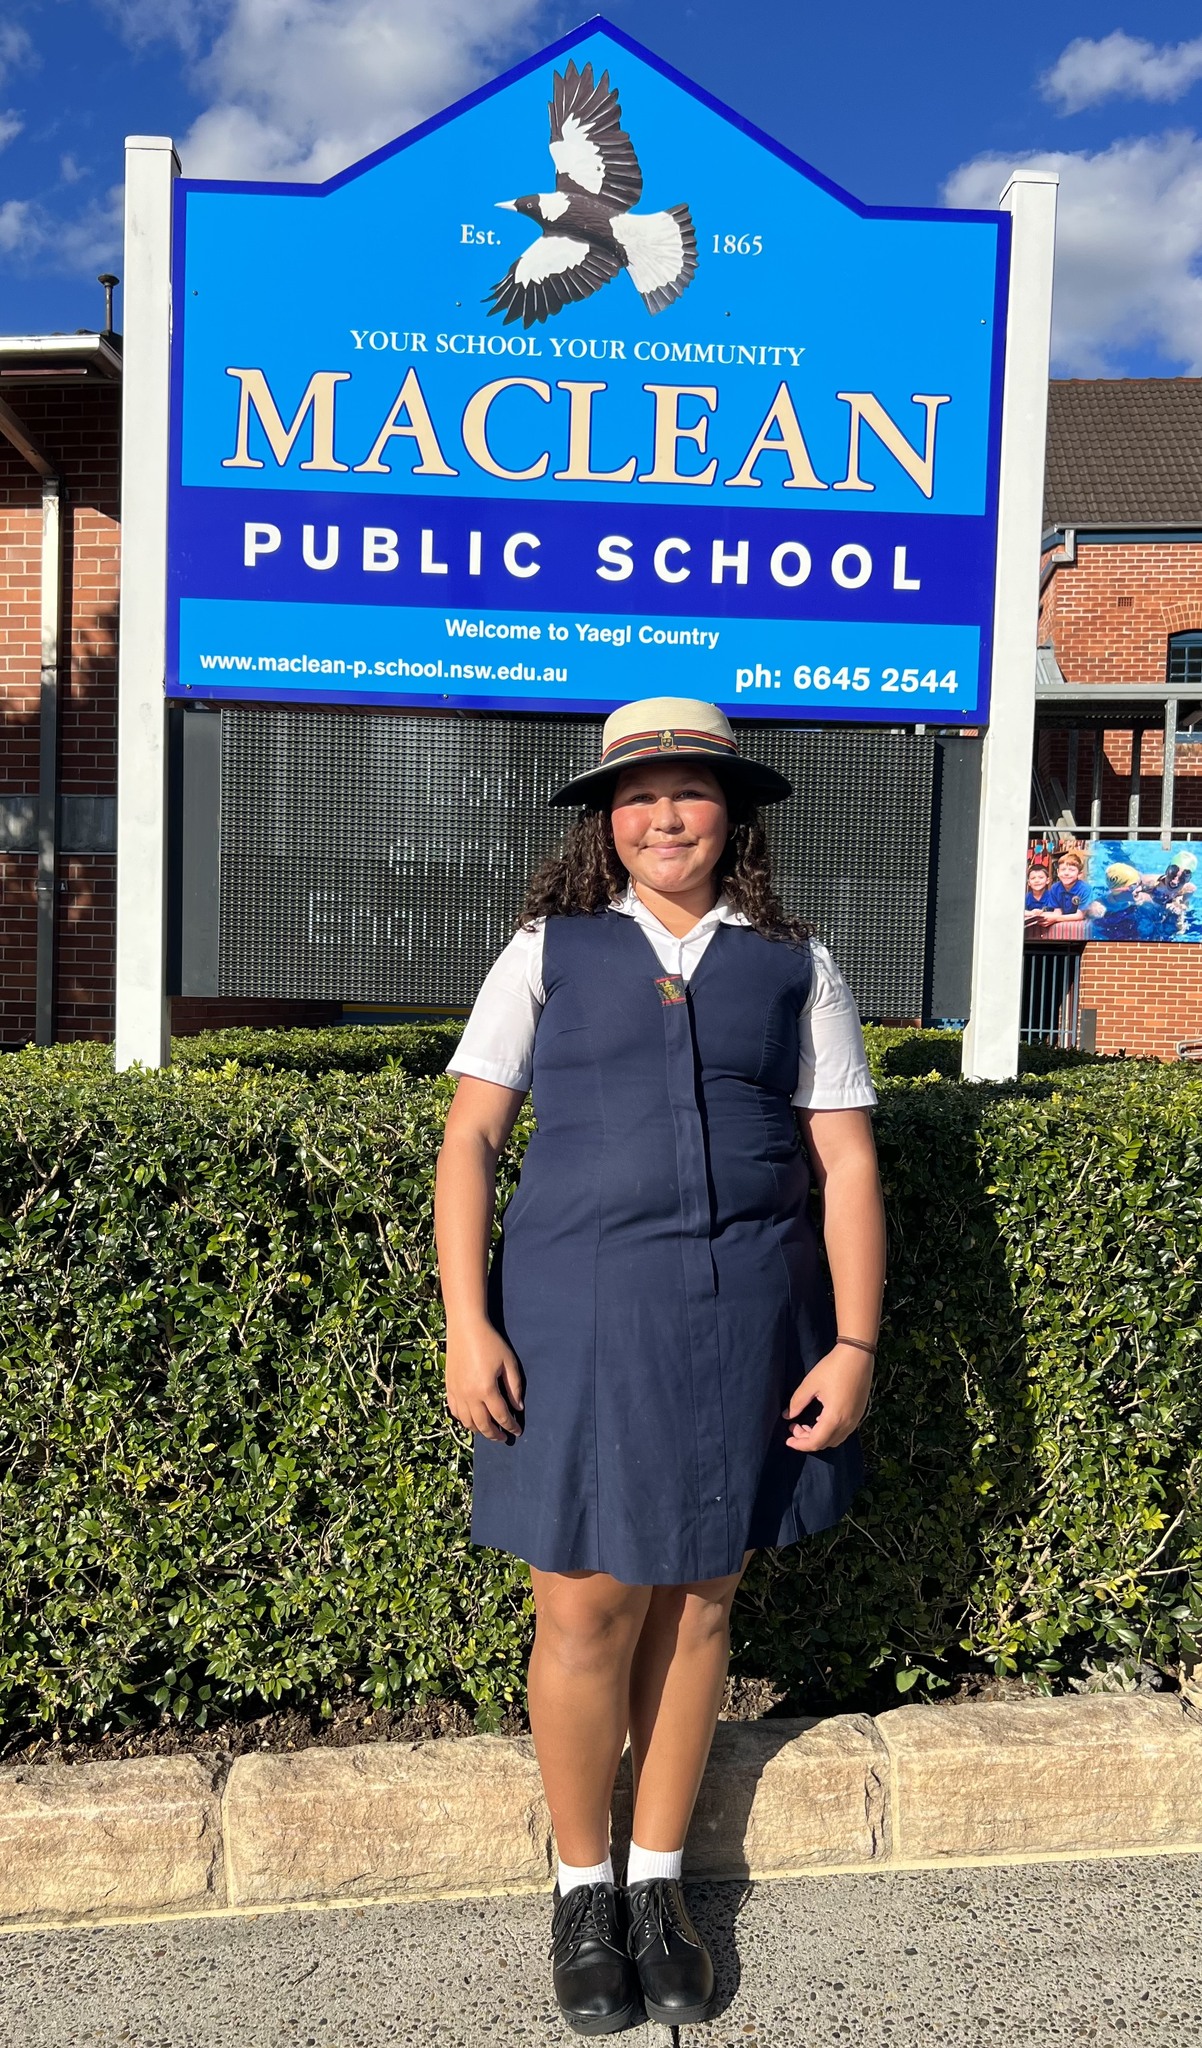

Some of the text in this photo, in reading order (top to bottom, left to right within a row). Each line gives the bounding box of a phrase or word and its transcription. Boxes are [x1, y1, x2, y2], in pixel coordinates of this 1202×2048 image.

[461, 224, 501, 245] Est.
[713, 234, 763, 255] 1865
[351, 330, 805, 367] YOUR SCHOOL YOUR COMMUNITY
[222, 366, 951, 499] MACLEAN
[243, 522, 921, 591] PUBLIC SCHOOL
[445, 618, 720, 650] Welcome to Yaegl Country
[199, 655, 568, 683] www.maclean-p.school.nsw.edu.au
[735, 664, 959, 694] ph: 6645 2544
